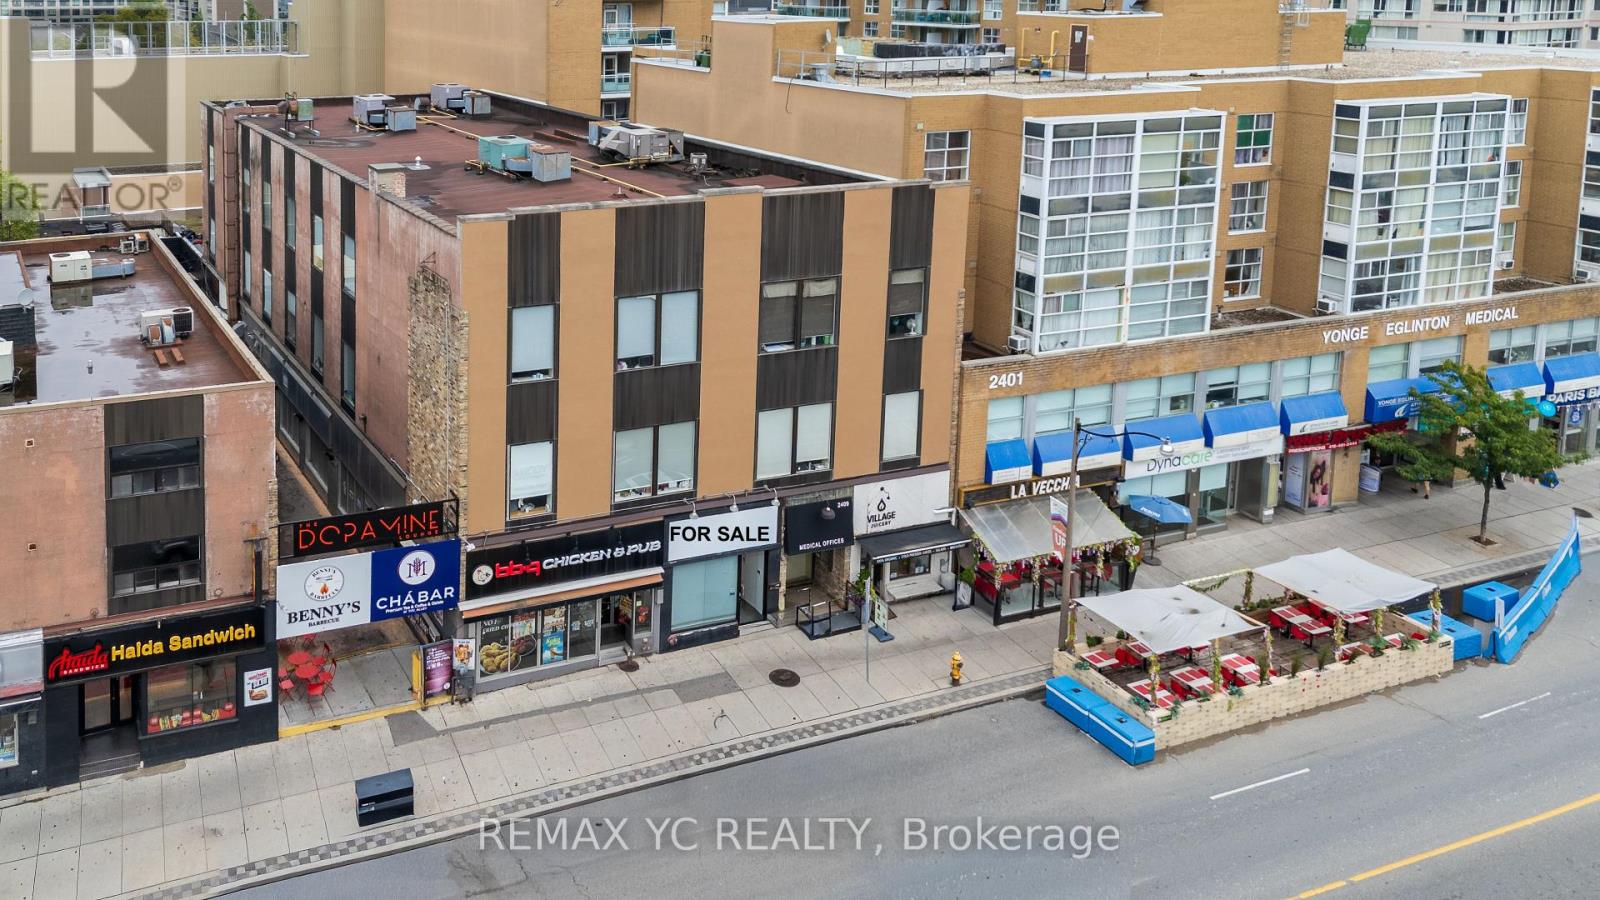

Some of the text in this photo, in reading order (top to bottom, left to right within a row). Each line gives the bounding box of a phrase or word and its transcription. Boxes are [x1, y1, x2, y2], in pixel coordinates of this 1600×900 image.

[1322, 306, 1519, 345] YONGE EGLINTON MEDICAL
[989, 371, 1024, 389] 2401
[1548, 388, 1586, 404] PARIS
[1147, 450, 1213, 472] Dynacare
[1011, 484, 1026, 500] LA
[1032, 475, 1080, 496] VECCHA
[867, 511, 896, 523] VILLAGE
[299, 510, 439, 551] DOPAMINE
[399, 530, 439, 540] LOUNGE
[670, 526, 770, 542] FOR SALE
[799, 537, 845, 551] MEDICAL OFFICES
[542, 548, 611, 570] CHICKEN
[613, 547, 625, 558] &
[626, 540, 662, 556] PUB
[287, 600, 361, 625] BENNY'S
[308, 617, 340, 628] BARBECUE
[111, 623, 256, 662] Haida Sandwich
[63, 663, 106, 675] SANDWICH
